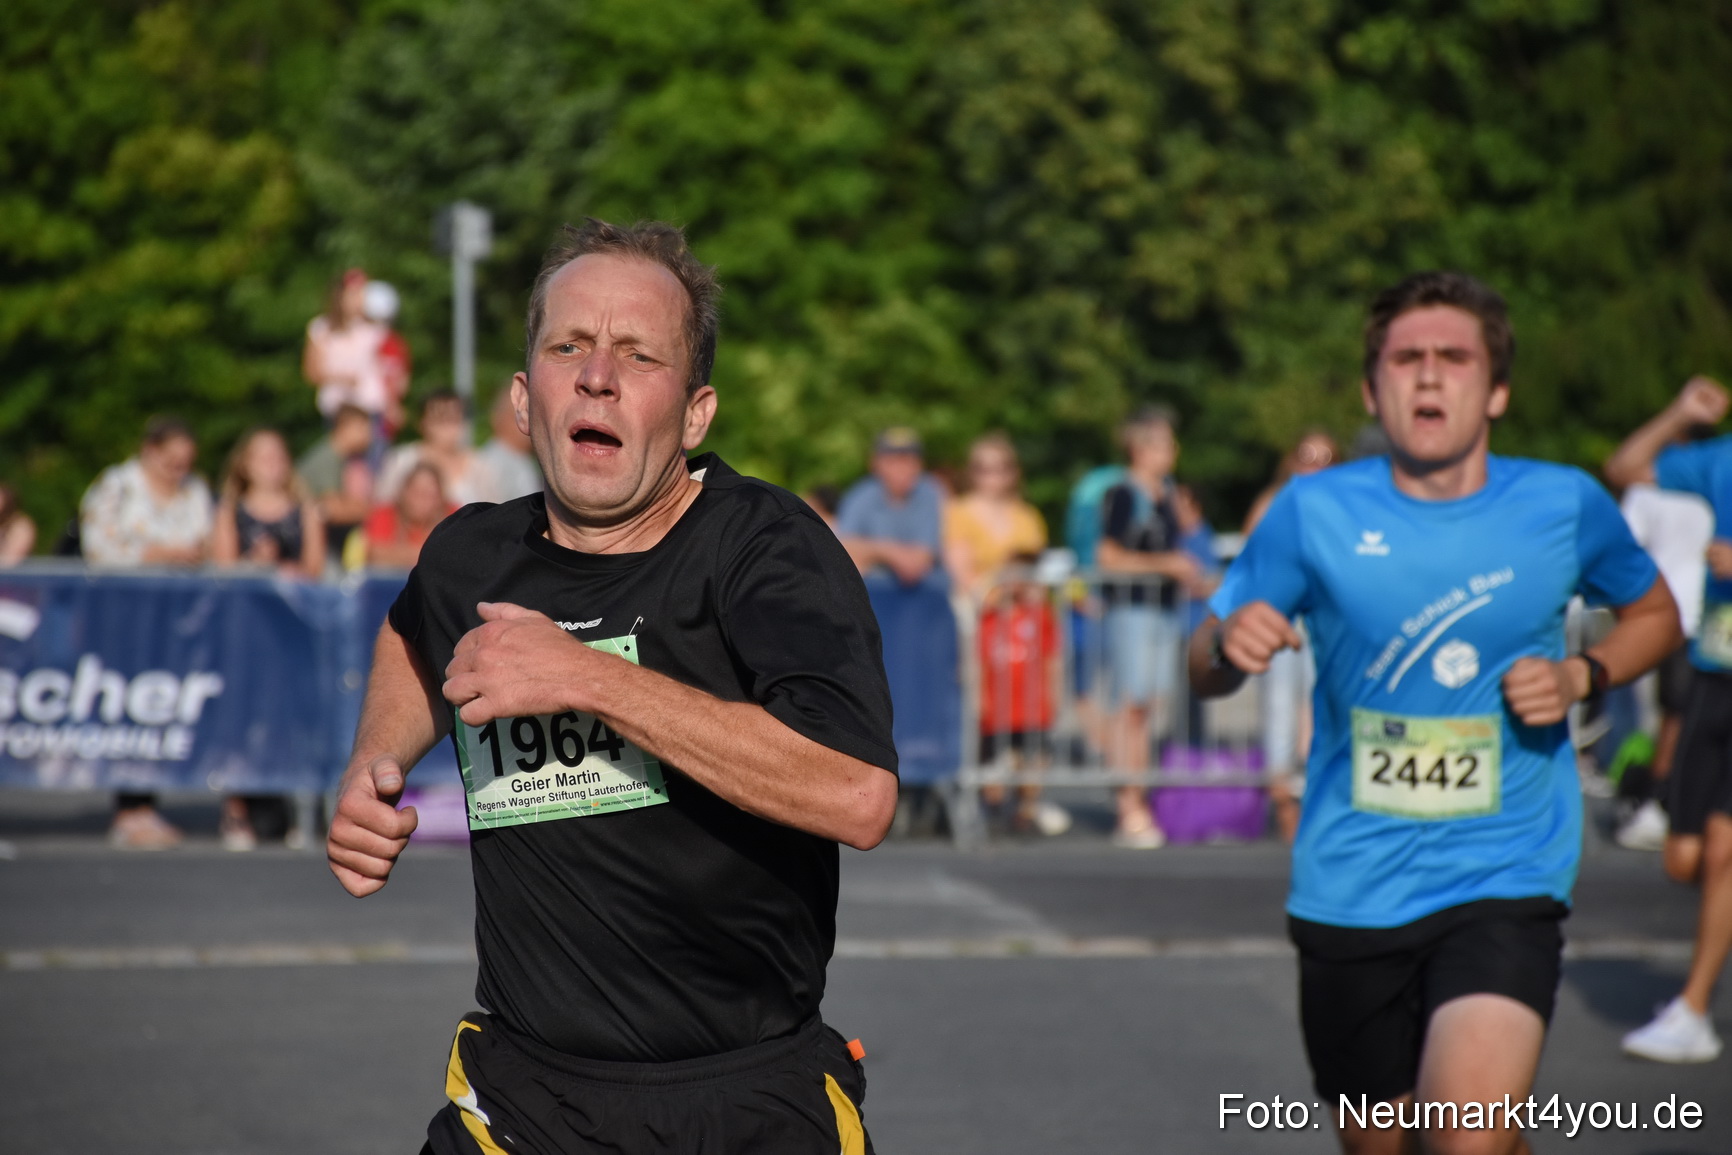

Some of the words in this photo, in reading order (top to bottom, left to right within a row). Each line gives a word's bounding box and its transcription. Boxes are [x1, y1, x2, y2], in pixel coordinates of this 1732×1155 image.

[1366, 634, 1406, 680] Team
[1401, 587, 1468, 638] Schick
[1469, 566, 1514, 595] Bau
[478, 711, 625, 777] 1964
[511, 776, 551, 793] Geier
[555, 769, 601, 787] Martin
[1371, 749, 1480, 790] 2442
[477, 800, 507, 812] Regens
[508, 793, 546, 810] Wagner
[548, 789, 587, 803] Stiftung
[588, 780, 650, 798] Lauterhofen
